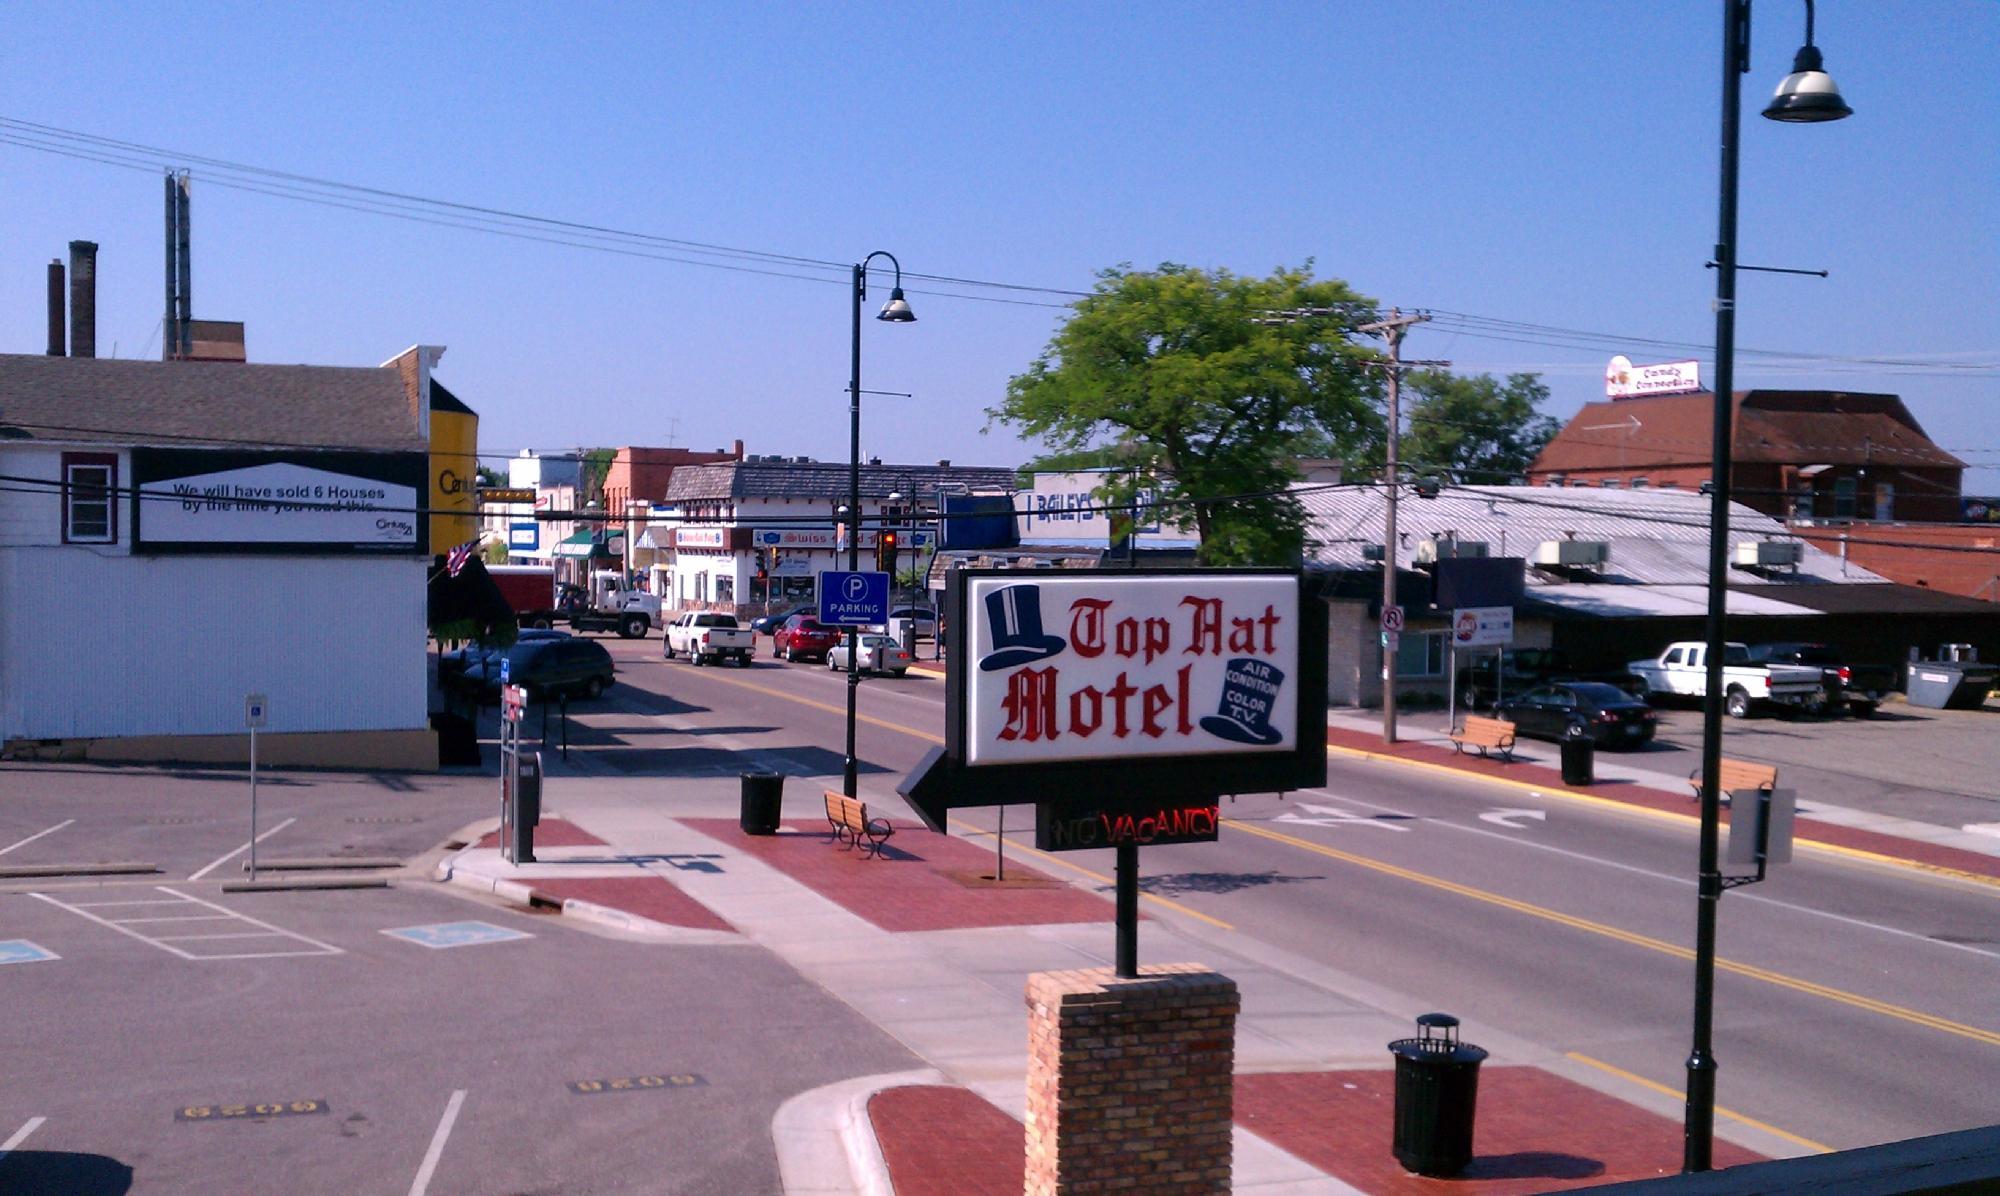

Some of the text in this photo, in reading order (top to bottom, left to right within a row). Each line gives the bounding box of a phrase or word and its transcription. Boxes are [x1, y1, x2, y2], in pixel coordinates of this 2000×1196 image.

[173, 484, 385, 499] We will have sold 6 Houses
[182, 499, 201, 514] by
[206, 499, 232, 511] the
[274, 503, 301, 514] you
[850, 579, 863, 598] P
[830, 603, 879, 613] PARKING
[1069, 595, 1281, 666] Top Hat
[1242, 661, 1270, 679] AIR
[1226, 670, 1278, 697] CONDITION
[997, 663, 1194, 742] Motel
[1226, 690, 1266, 713] COLOR
[1230, 704, 1257, 724] T.V.
[1053, 806, 1219, 845] NO VACANCY
